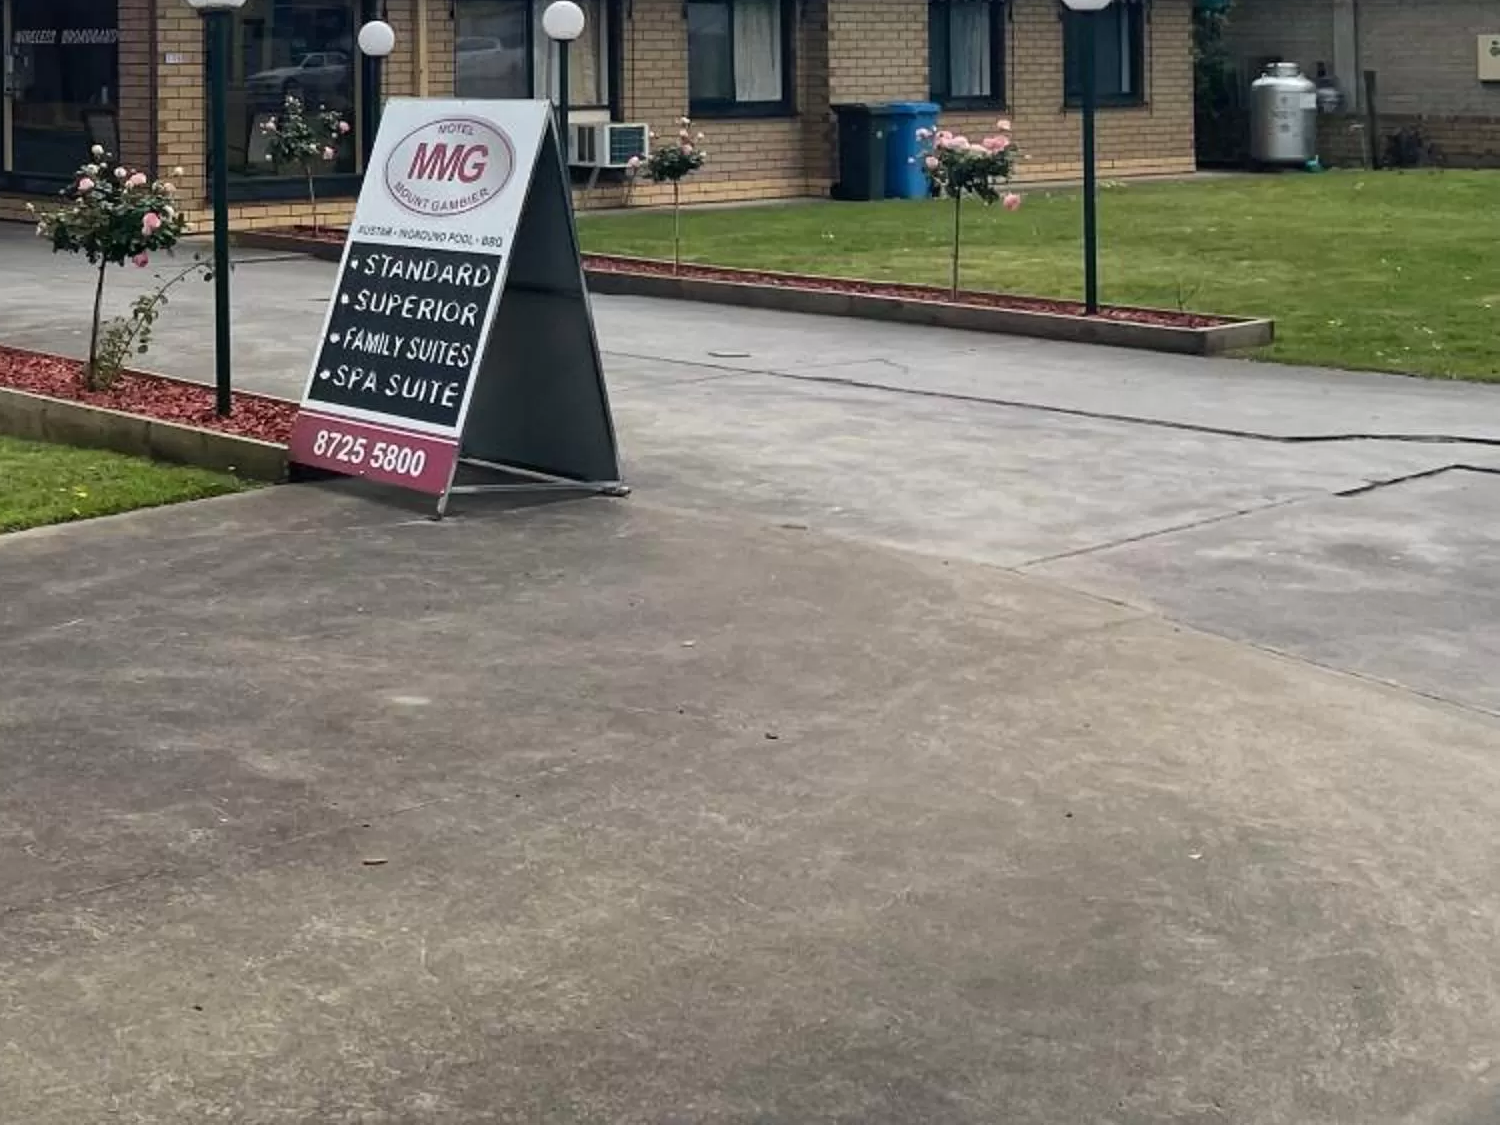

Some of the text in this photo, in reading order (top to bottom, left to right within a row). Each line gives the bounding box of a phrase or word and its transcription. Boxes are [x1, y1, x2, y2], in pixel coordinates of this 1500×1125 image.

[438, 124, 475, 136] MOTEL
[407, 142, 489, 183] MMG
[394, 180, 490, 212] MOUNT GAMBIER
[447, 232, 473, 245] POOL
[481, 236, 503, 248] BBQ
[364, 254, 491, 287] STANDARD
[353, 289, 479, 327] SUPERIOR
[343, 327, 472, 368] FAMILY SUITES
[332, 364, 460, 407] SPA SUITE
[313, 430, 426, 477] 8725 5800
